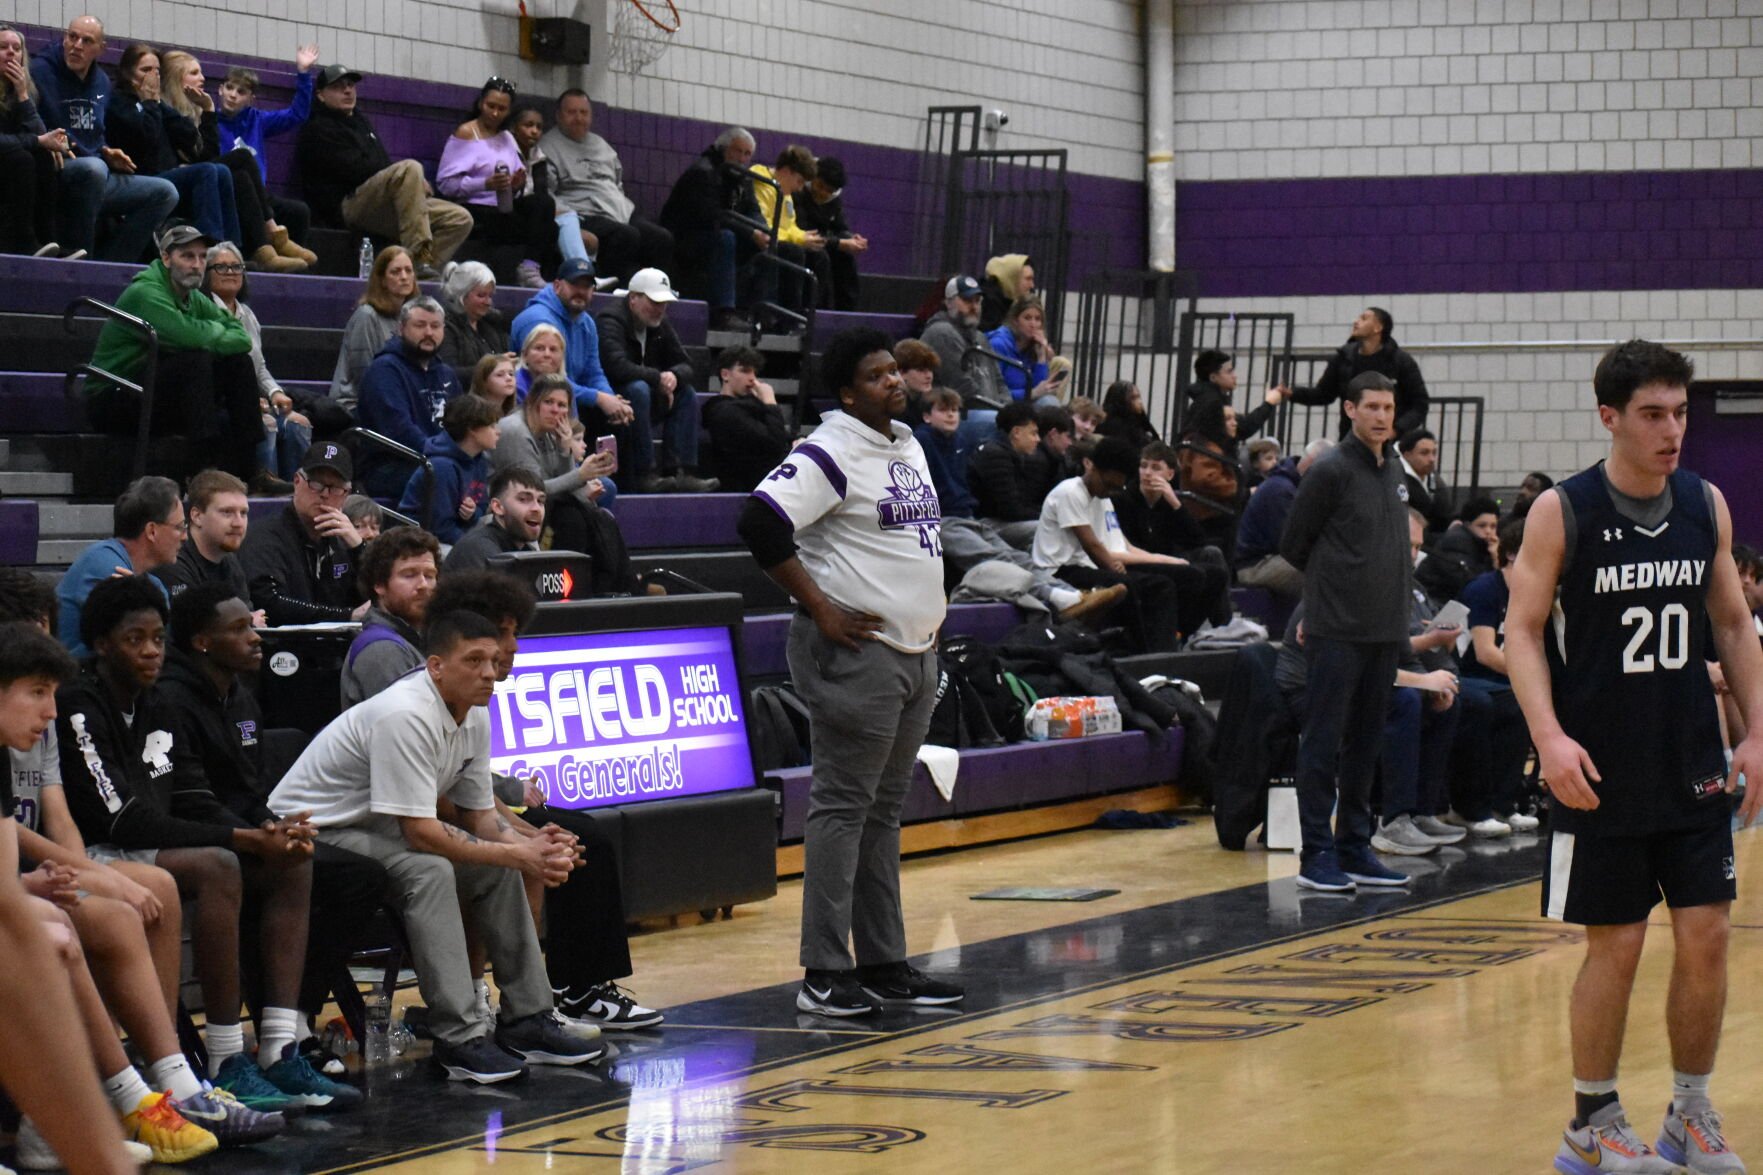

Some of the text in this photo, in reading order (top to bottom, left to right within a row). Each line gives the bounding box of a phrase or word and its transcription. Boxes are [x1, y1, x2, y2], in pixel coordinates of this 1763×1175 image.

[324, 445, 338, 459] P
[767, 463, 798, 481] P
[541, 573, 564, 595] POSS
[1594, 559, 1706, 594] MEDWAY
[1621, 603, 1689, 674] 20
[679, 664, 720, 695] HIGH
[494, 664, 671, 750] TSFIELD
[673, 693, 738, 728] SCHOOL
[236, 720, 256, 740] P
[558, 744, 684, 802] Generals!
